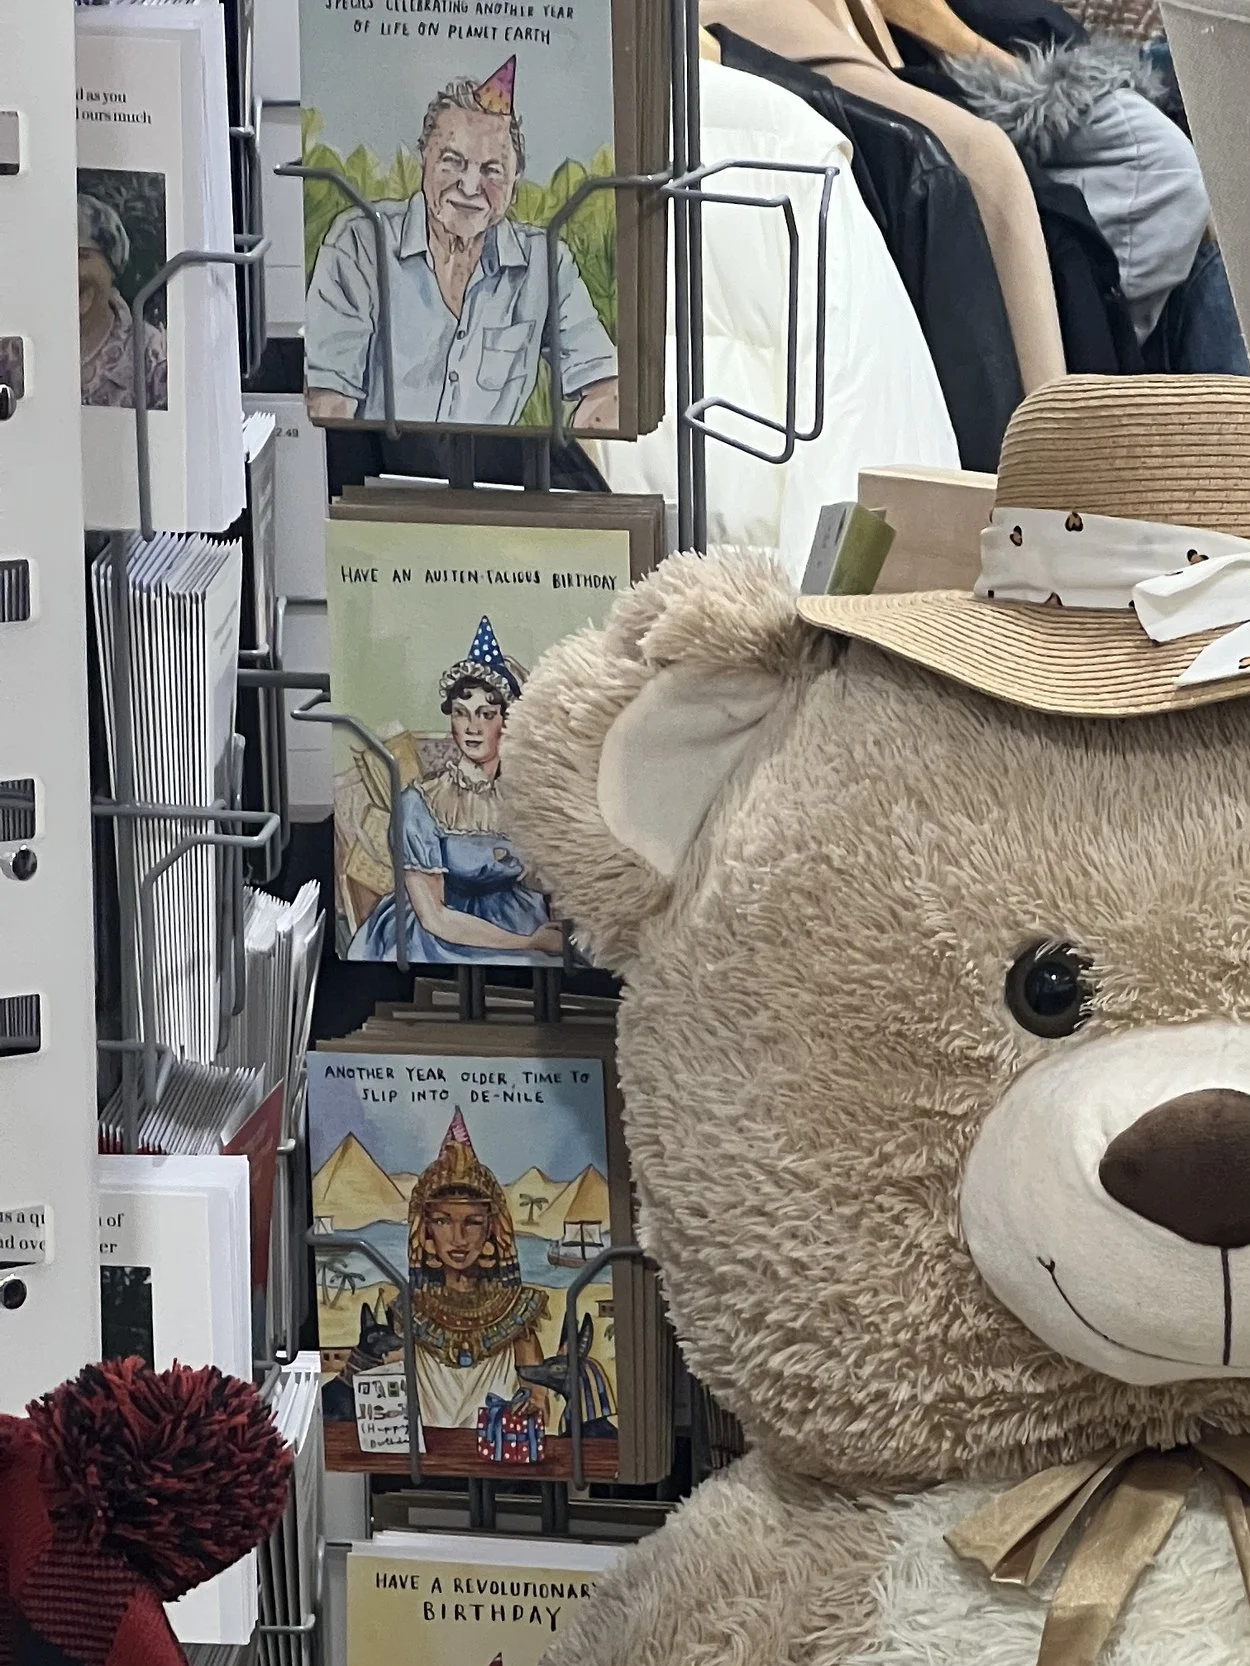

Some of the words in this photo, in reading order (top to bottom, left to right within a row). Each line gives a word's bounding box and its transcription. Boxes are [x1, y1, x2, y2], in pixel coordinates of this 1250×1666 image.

[475, 2, 534, 17] ANOTHER
[543, 5, 574, 20] YEAR
[353, 20, 370, 33] OF
[380, 22, 410, 36] LIFE
[417, 22, 440, 36] ON
[448, 25, 497, 40] PLANET
[504, 26, 550, 45] EARTH
[102, 92, 127, 105] you
[113, 109, 152, 124] much
[340, 565, 379, 583] HAVE
[392, 568, 412, 583] AN
[552, 572, 618, 591] BIRTHDAY
[325, 1065, 395, 1081] ANOTHER
[405, 1066, 447, 1082] YEAR
[523, 1071, 562, 1084] TIME
[571, 1070, 591, 1084] TO
[362, 1088, 398, 1103] SLIP
[411, 1089, 450, 1102] INTO
[470, 1090, 545, 1104] DE-NILE
[16, 1211, 26, 1223] a
[106, 1212, 125, 1228] of
[376, 1571, 420, 1590] HAVE
[431, 1577, 443, 1594] A
[423, 1601, 562, 1632] BIRTHDAY
